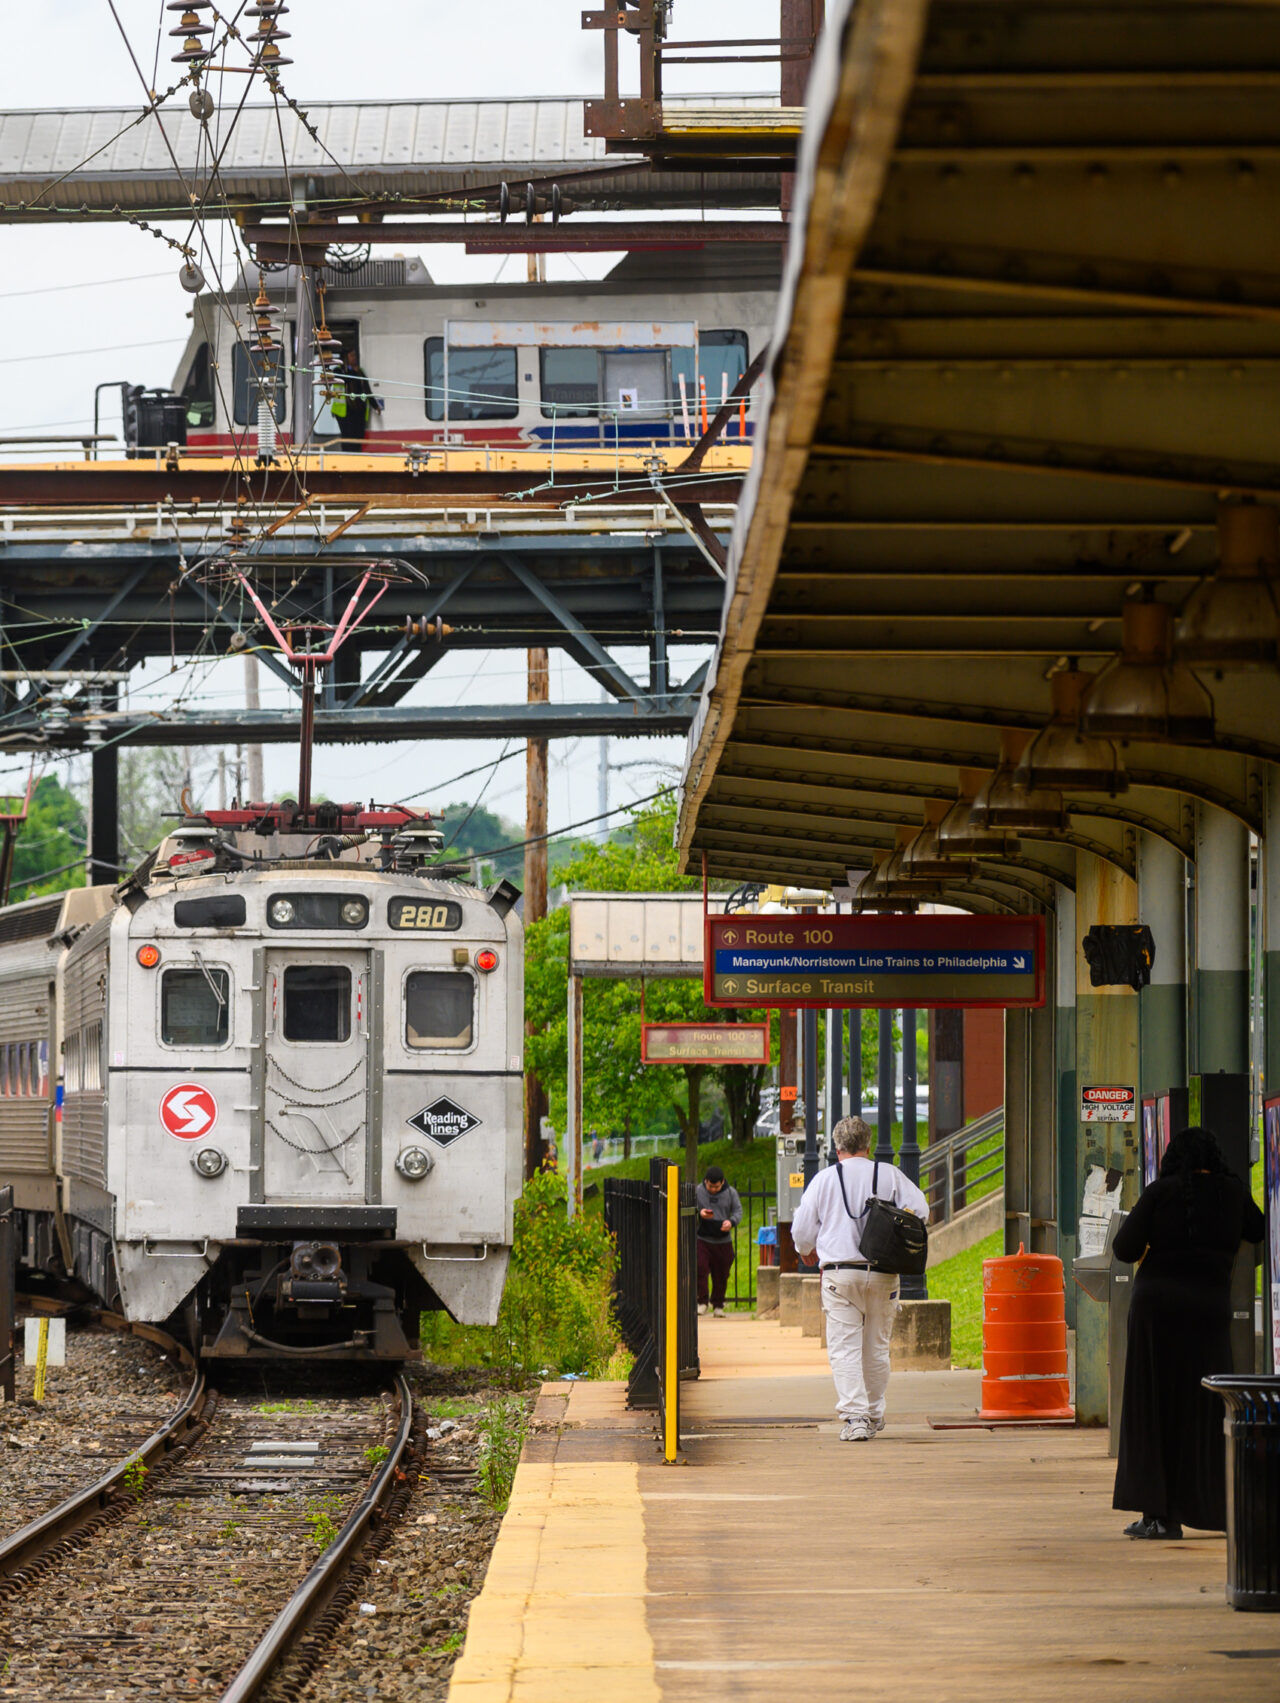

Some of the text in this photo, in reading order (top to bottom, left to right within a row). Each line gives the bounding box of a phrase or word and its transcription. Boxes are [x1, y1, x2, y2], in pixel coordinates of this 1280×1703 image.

[400, 905, 448, 928] 280
[745, 930, 833, 944] Route 100
[732, 956, 1007, 969] Manayunk/Norristown Line Trains to Philadelphia
[746, 979, 875, 994] Surface Transit
[693, 1032, 746, 1041] Route 100
[669, 1046, 746, 1056] Surface Transit
[1088, 1090, 1129, 1100] DANGER
[423, 1111, 469, 1129] Reading
